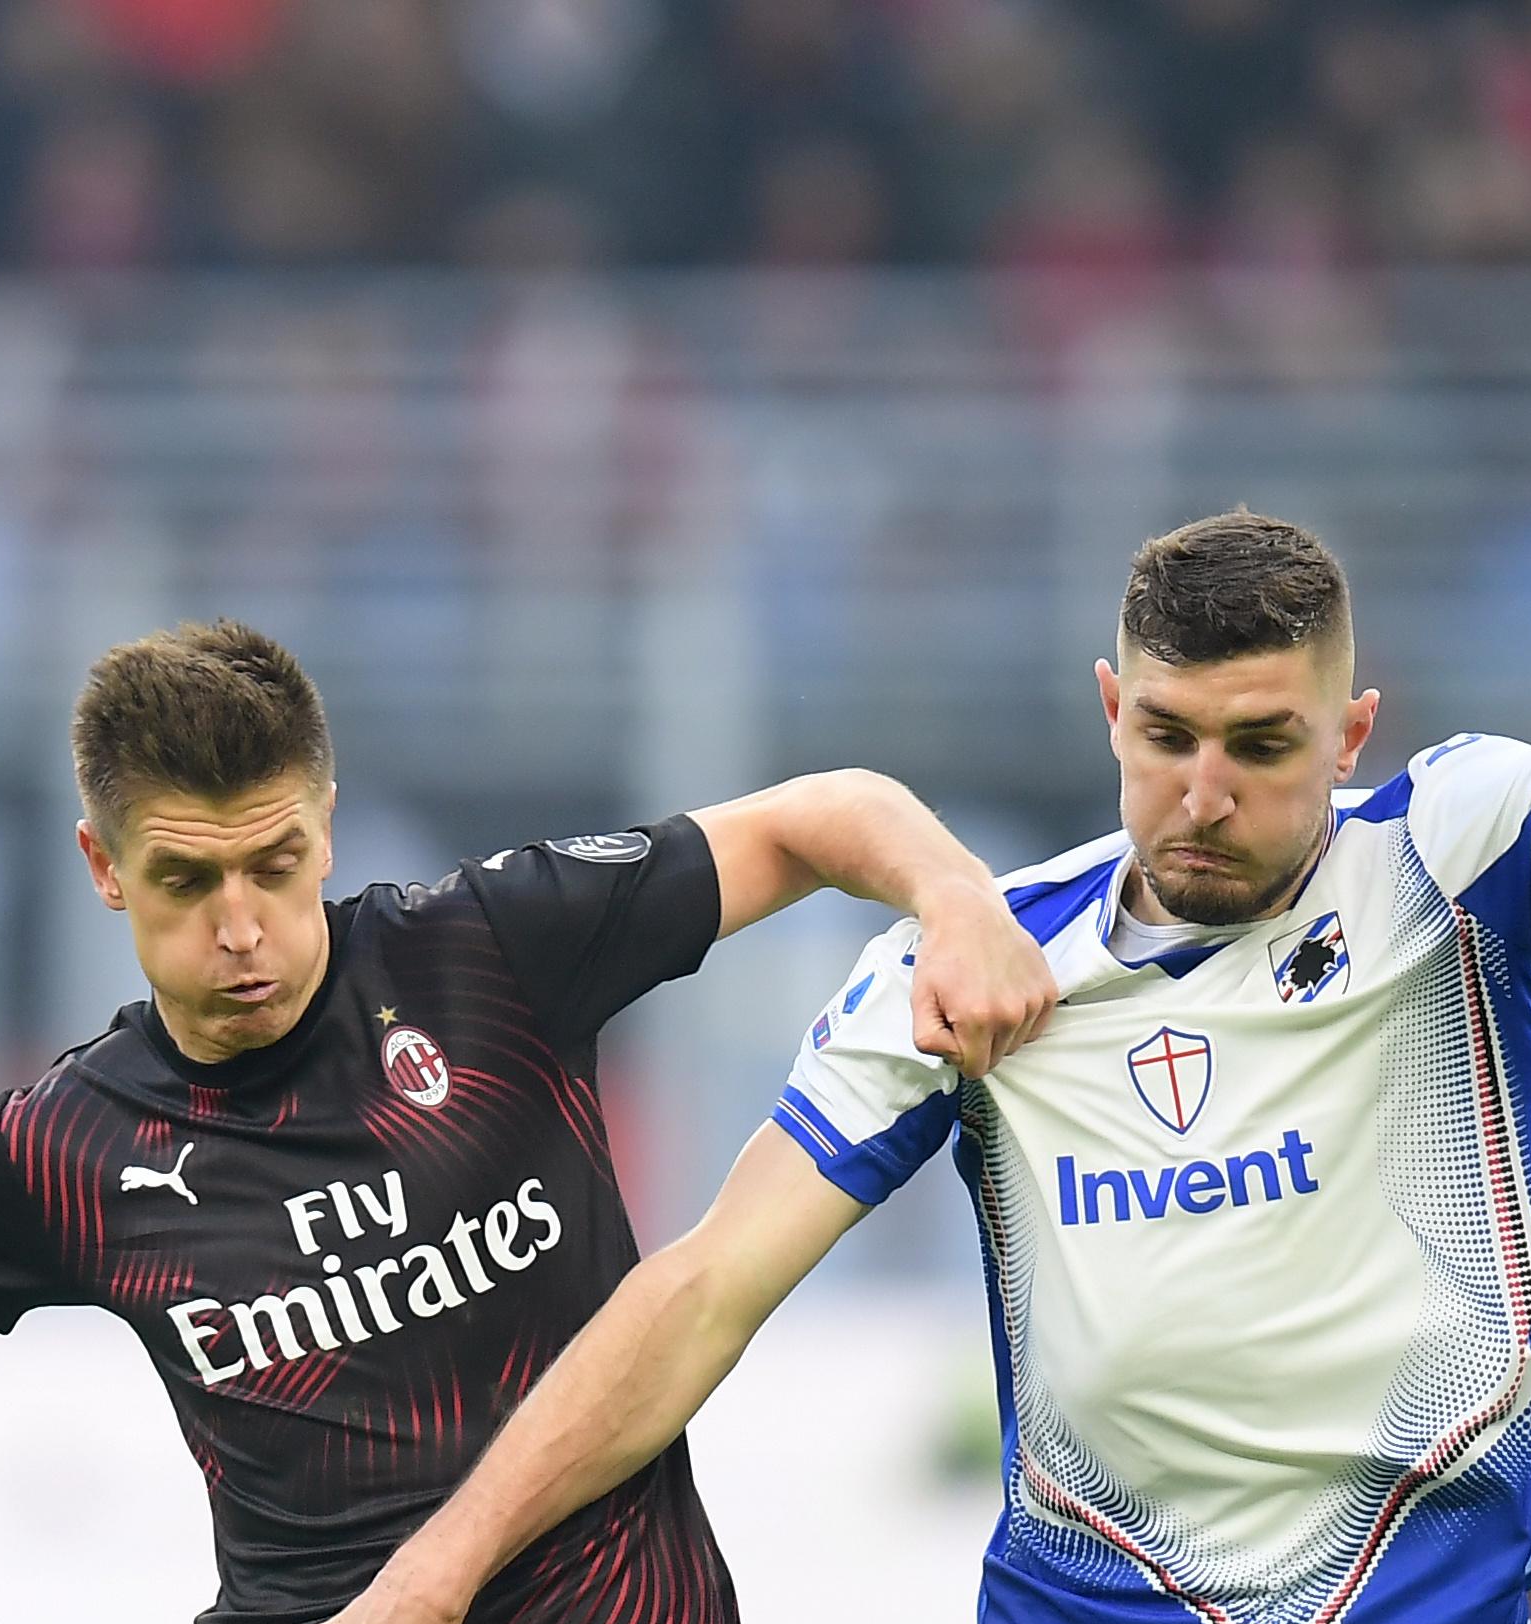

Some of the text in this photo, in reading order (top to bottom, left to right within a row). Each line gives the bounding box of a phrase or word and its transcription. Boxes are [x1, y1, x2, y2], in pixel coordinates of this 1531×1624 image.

[420, 1083, 445, 1101] 1899
[283, 1169, 408, 1256] Fly
[1056, 1129, 1319, 1226] Invent
[166, 1177, 562, 1386] Emirates
